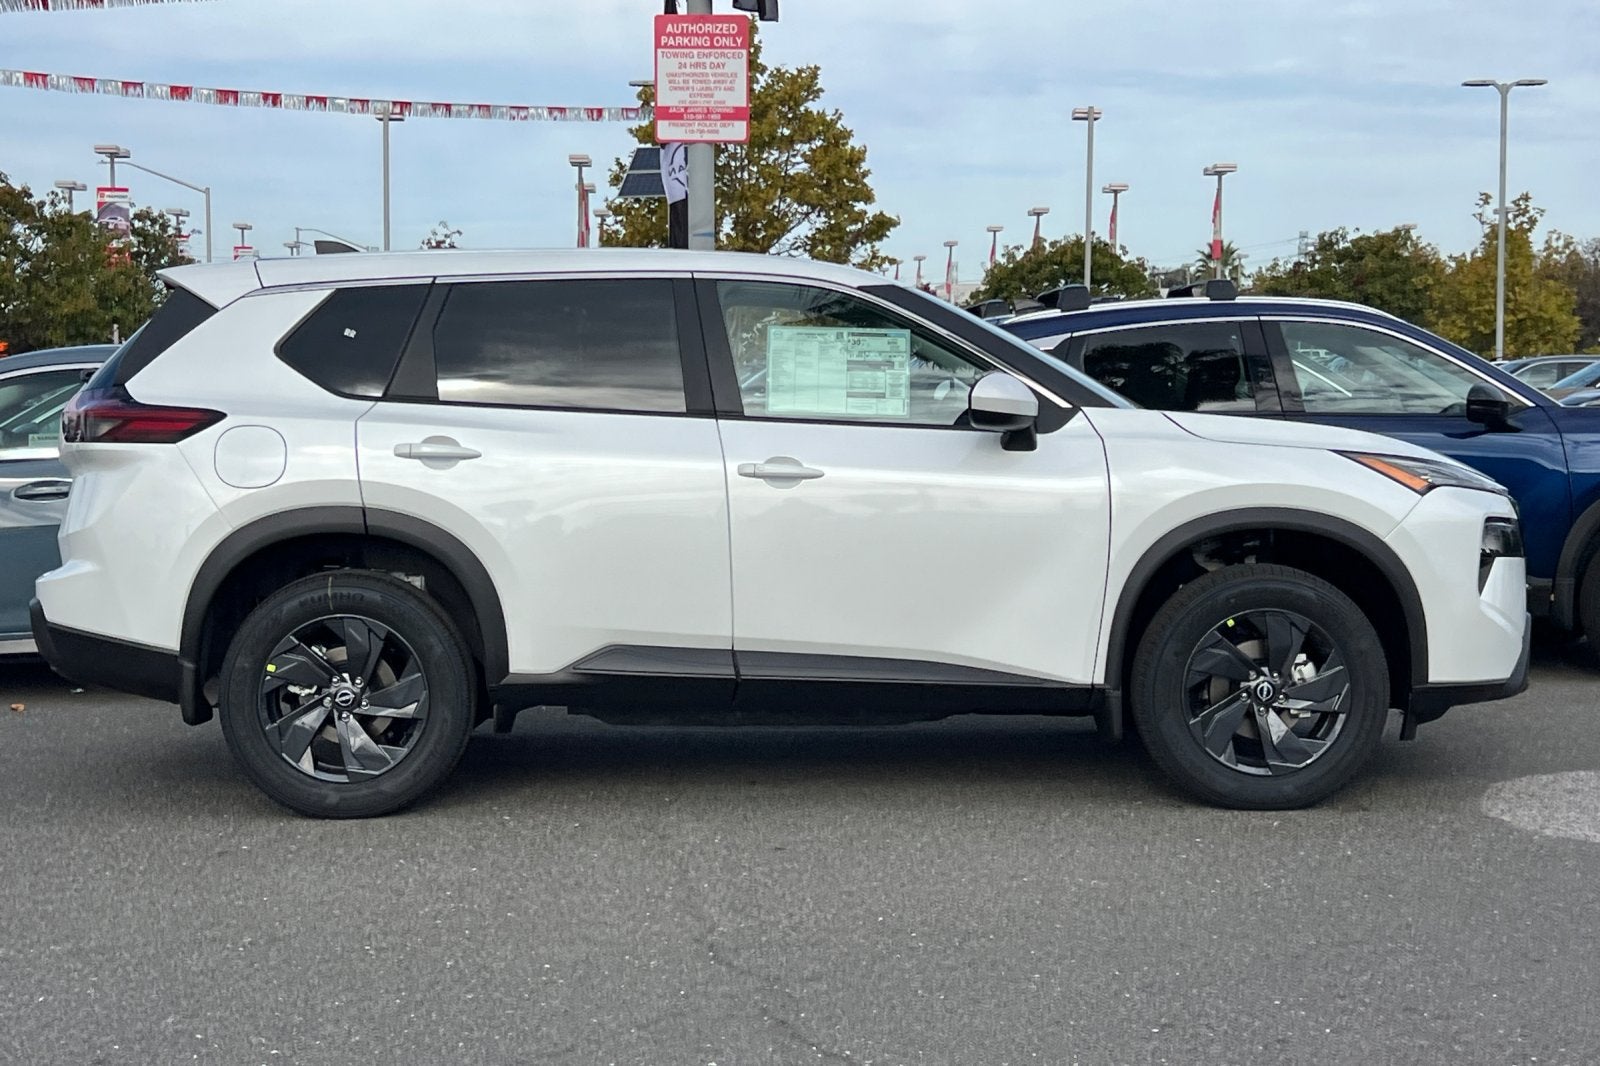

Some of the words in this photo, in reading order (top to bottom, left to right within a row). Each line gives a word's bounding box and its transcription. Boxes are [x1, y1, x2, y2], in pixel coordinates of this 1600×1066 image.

[666, 24, 738, 34] AUTHORIZED
[661, 36, 710, 47] PARKING
[713, 36, 743, 47] ONLY
[661, 51, 694, 59] TOWING
[696, 51, 743, 59] ENFORCED
[678, 62, 687, 70] 24
[689, 62, 707, 70] HRS
[709, 62, 726, 70] DAY
